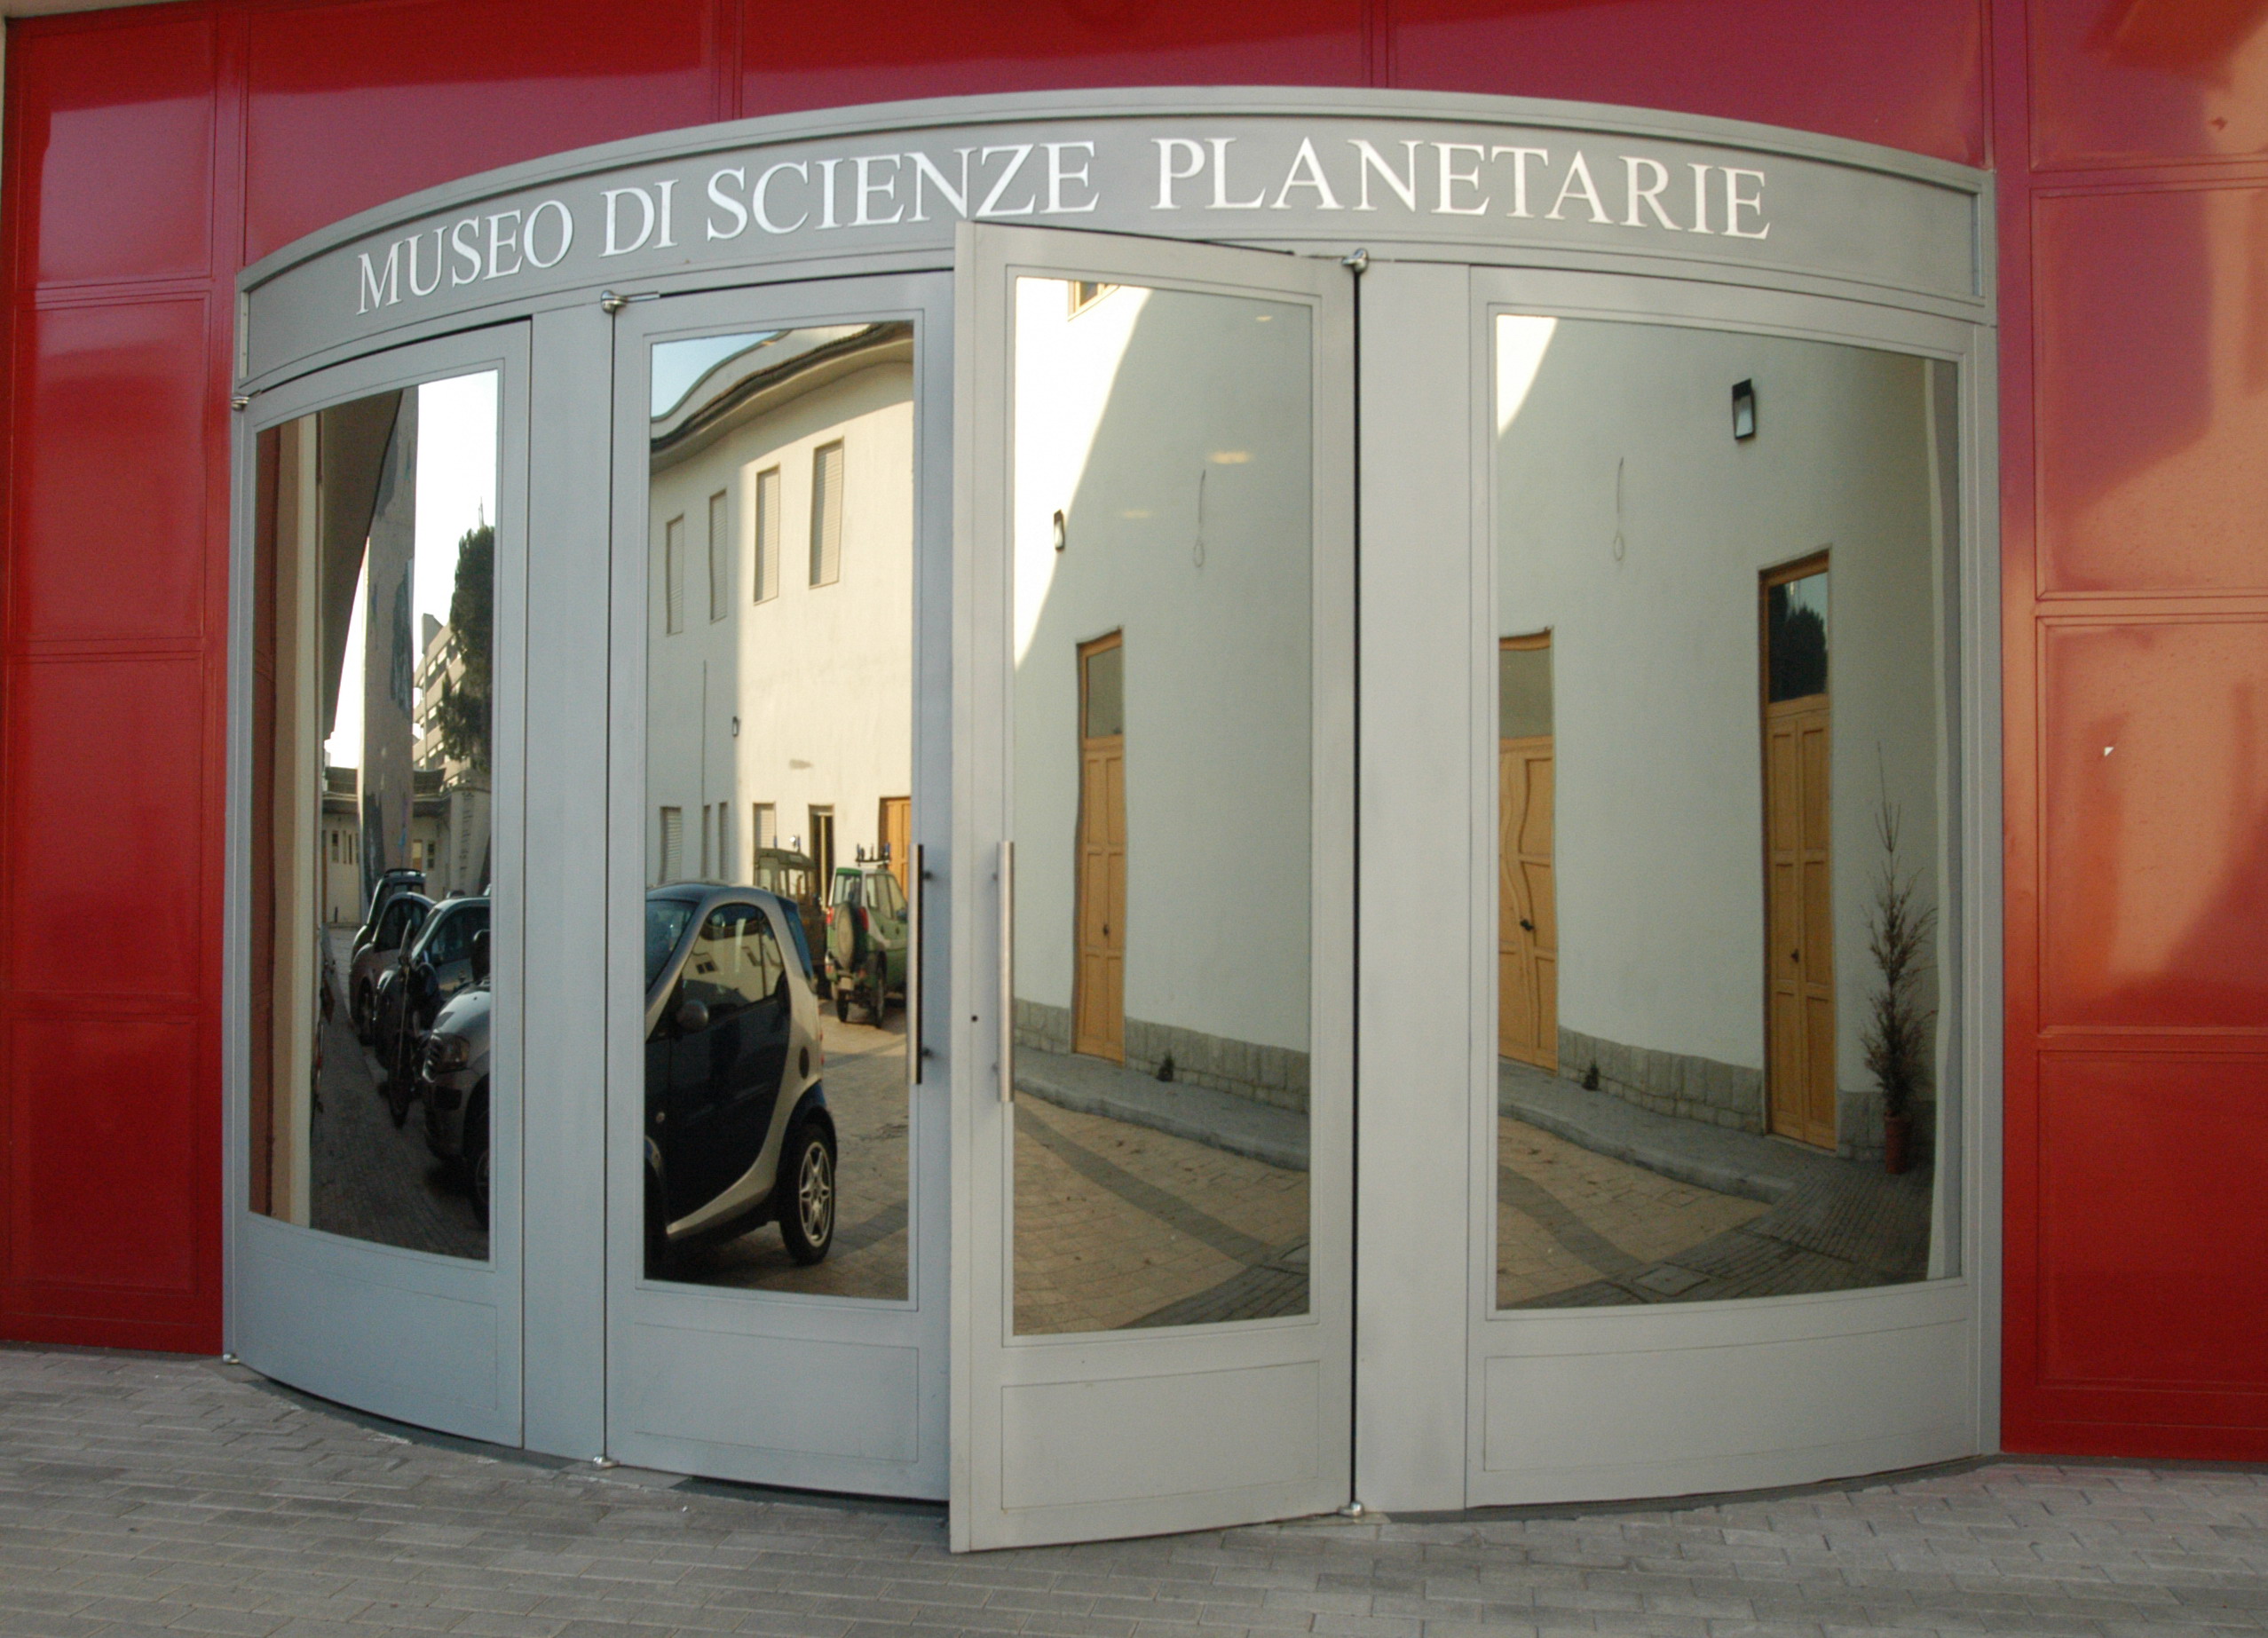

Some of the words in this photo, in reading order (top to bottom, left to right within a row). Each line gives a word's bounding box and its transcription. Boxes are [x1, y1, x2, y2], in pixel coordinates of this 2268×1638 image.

[357, 200, 573, 315] MUSEO
[598, 178, 680, 258] DI
[707, 140, 1100, 241] SCIENZE
[1150, 136, 1772, 240] PLANETARIE
